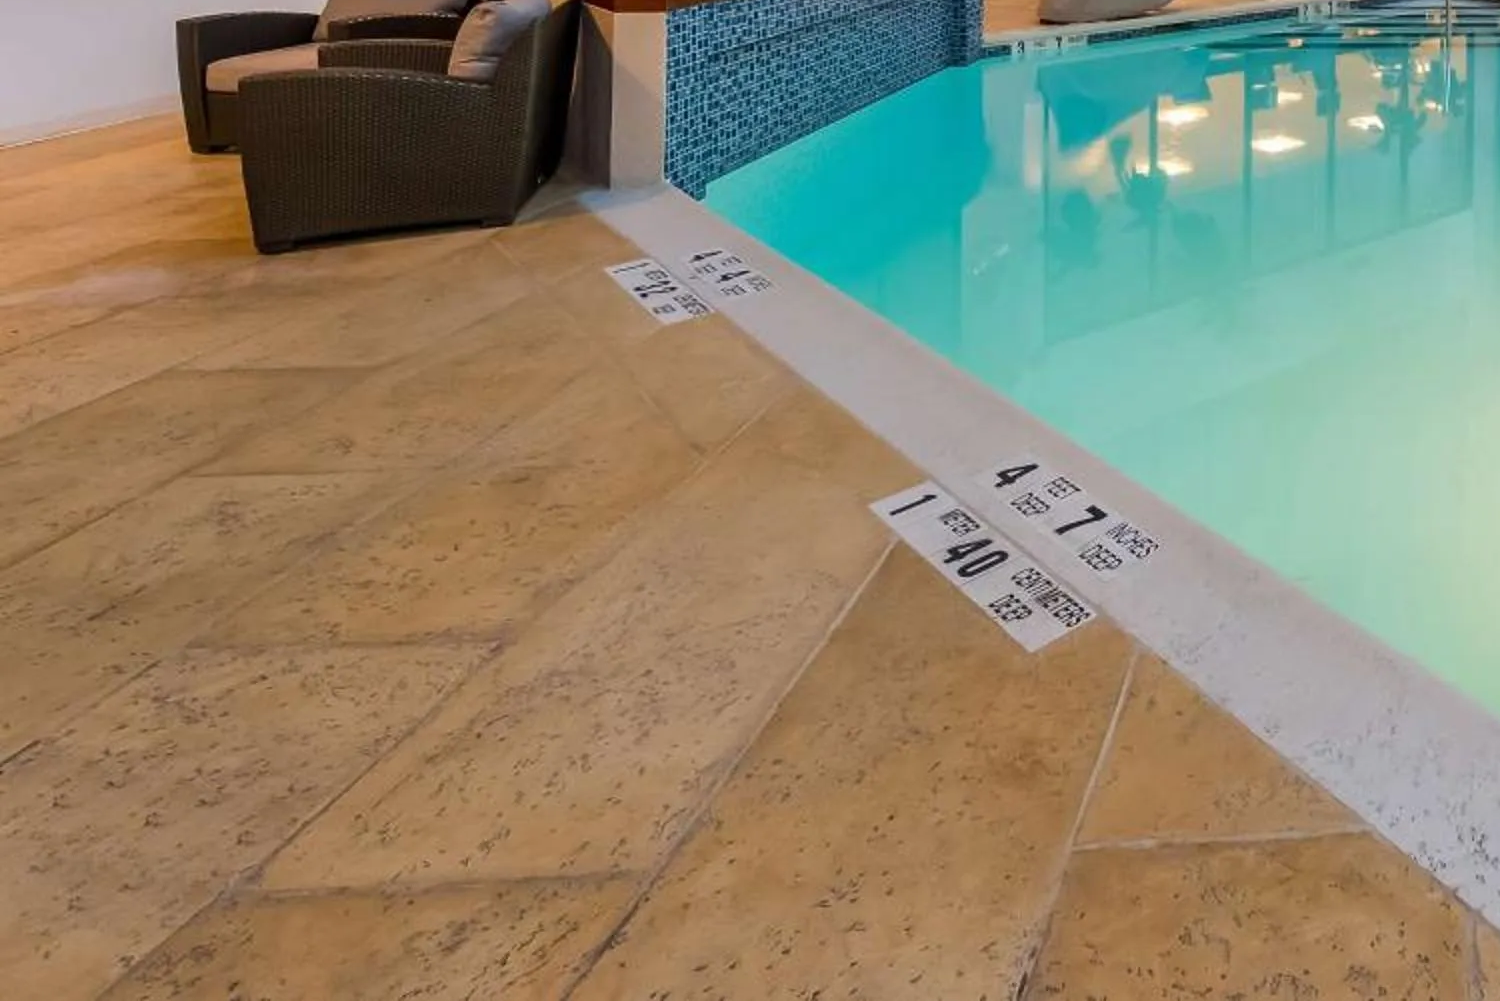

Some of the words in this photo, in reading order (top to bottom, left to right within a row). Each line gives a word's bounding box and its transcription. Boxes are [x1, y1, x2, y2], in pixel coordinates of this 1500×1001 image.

[888, 494, 938, 517] 1
[943, 538, 1010, 579] 40
[993, 462, 1040, 488] 4
[1054, 504, 1108, 535] 7
